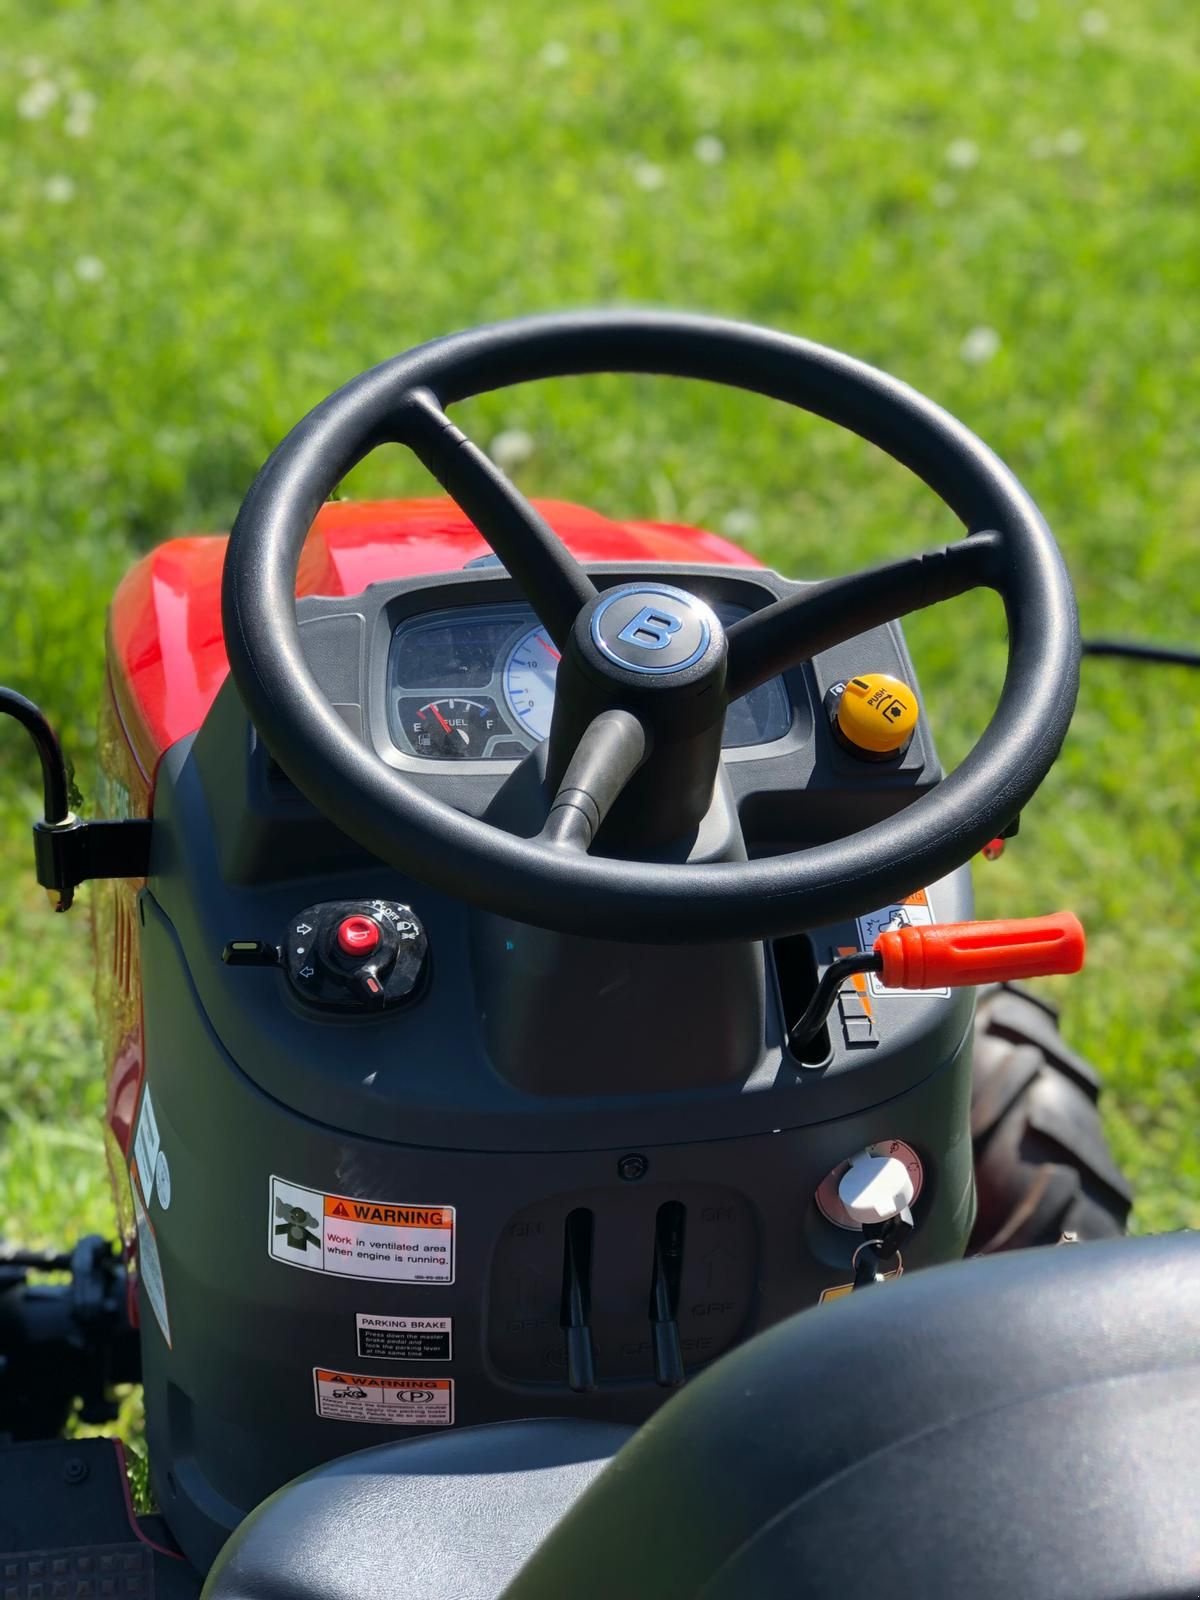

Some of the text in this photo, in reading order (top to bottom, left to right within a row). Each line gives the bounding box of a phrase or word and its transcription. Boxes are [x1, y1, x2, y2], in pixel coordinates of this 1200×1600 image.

[617, 606, 683, 650] B
[527, 661, 538, 669] 10
[867, 688, 887, 706] PUSH
[413, 723, 422, 732] E
[443, 718, 468, 727] FUEL
[486, 720, 494, 729] F
[385, 908, 399, 920] OFF
[354, 1206, 443, 1225] WARNING
[327, 1233, 352, 1245] Work
[356, 1239, 365, 1247] in
[370, 1240, 419, 1252] ventilated
[327, 1246, 449, 1266] when engine is running.
[362, 1318, 447, 1329] PARKING BRAKE
[351, 1377, 438, 1388] WARNING
